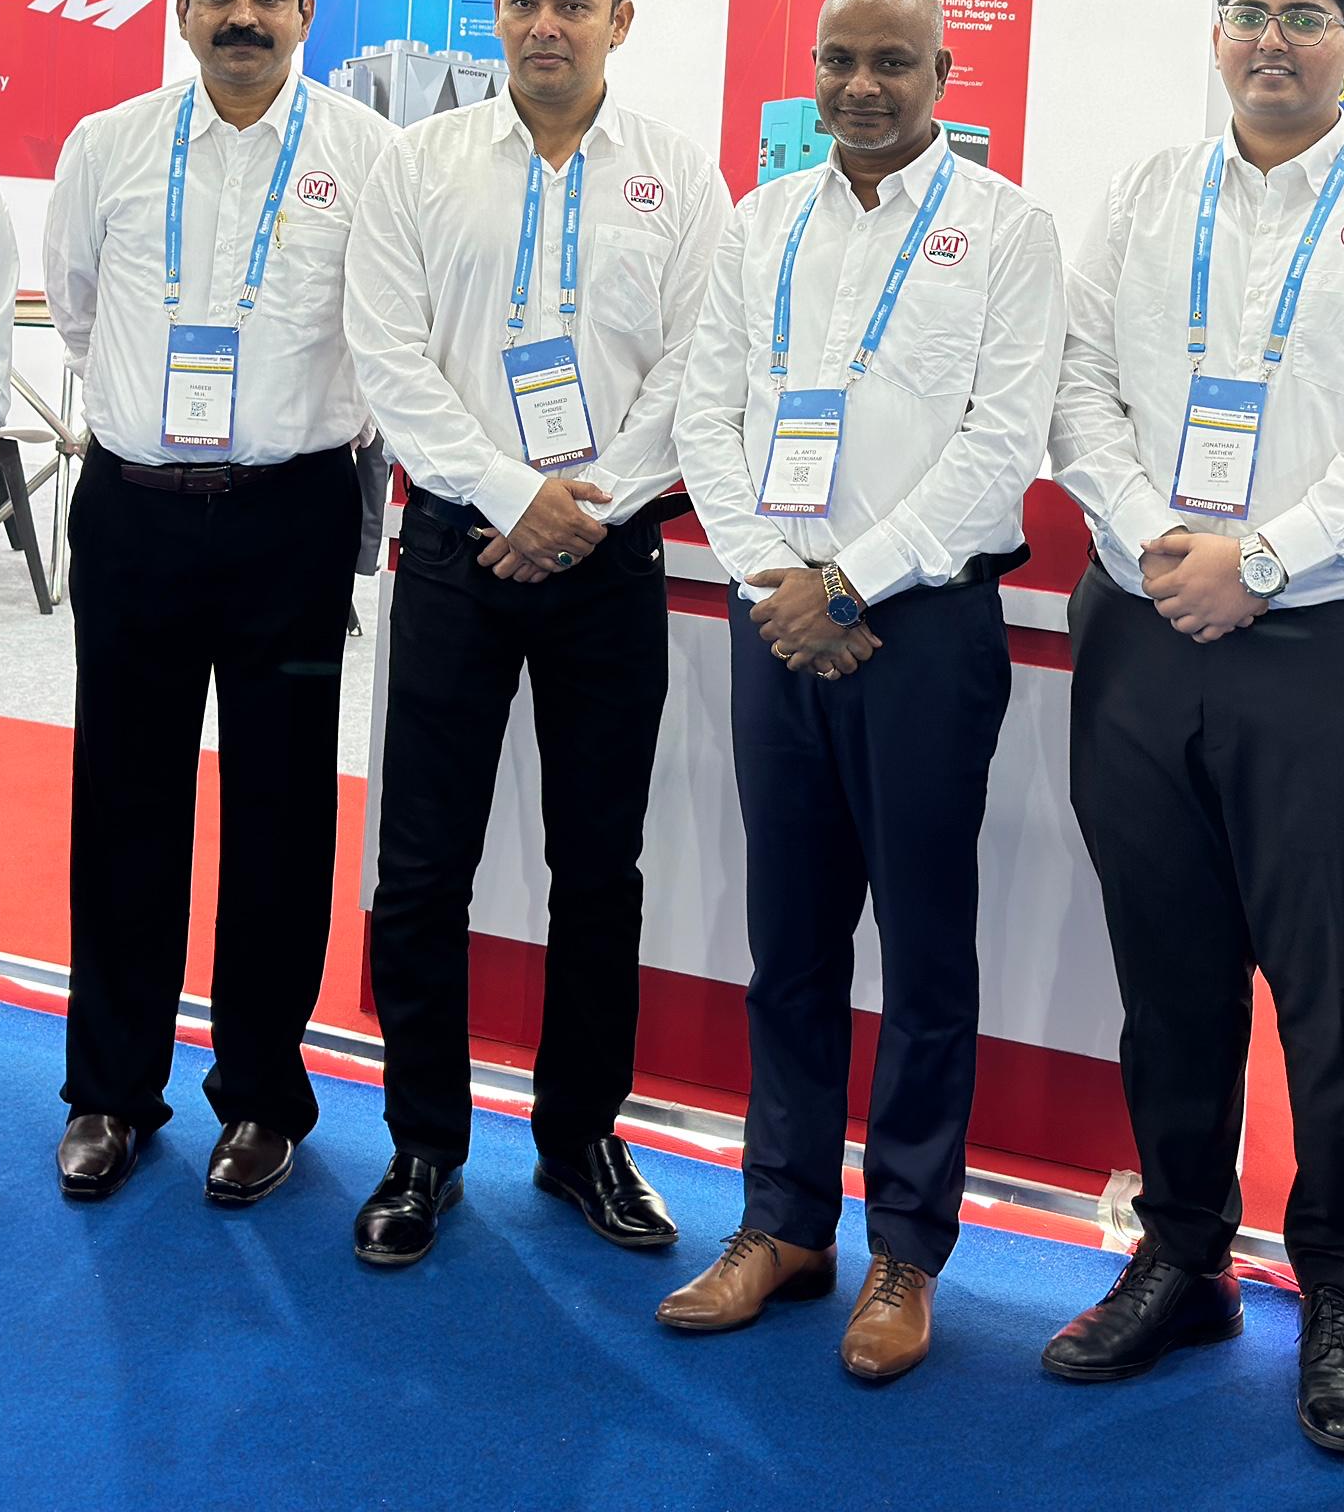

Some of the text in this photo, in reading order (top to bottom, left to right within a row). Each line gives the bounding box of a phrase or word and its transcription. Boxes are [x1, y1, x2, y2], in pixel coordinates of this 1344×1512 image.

[974, 0, 1008, 9] Service
[964, 10, 1007, 22] Pledge to
[946, 20, 993, 31] Tomorrow
[458, 68, 488, 78] MODERN
[950, 132, 989, 146] MODERN
[929, 250, 956, 259] MODERN
[174, 436, 219, 446] EXHIBITOR
[539, 450, 585, 467] EXHIBITOR
[769, 503, 816, 513] EXHIBITOR
[1185, 498, 1234, 513] EXHIBITOR
